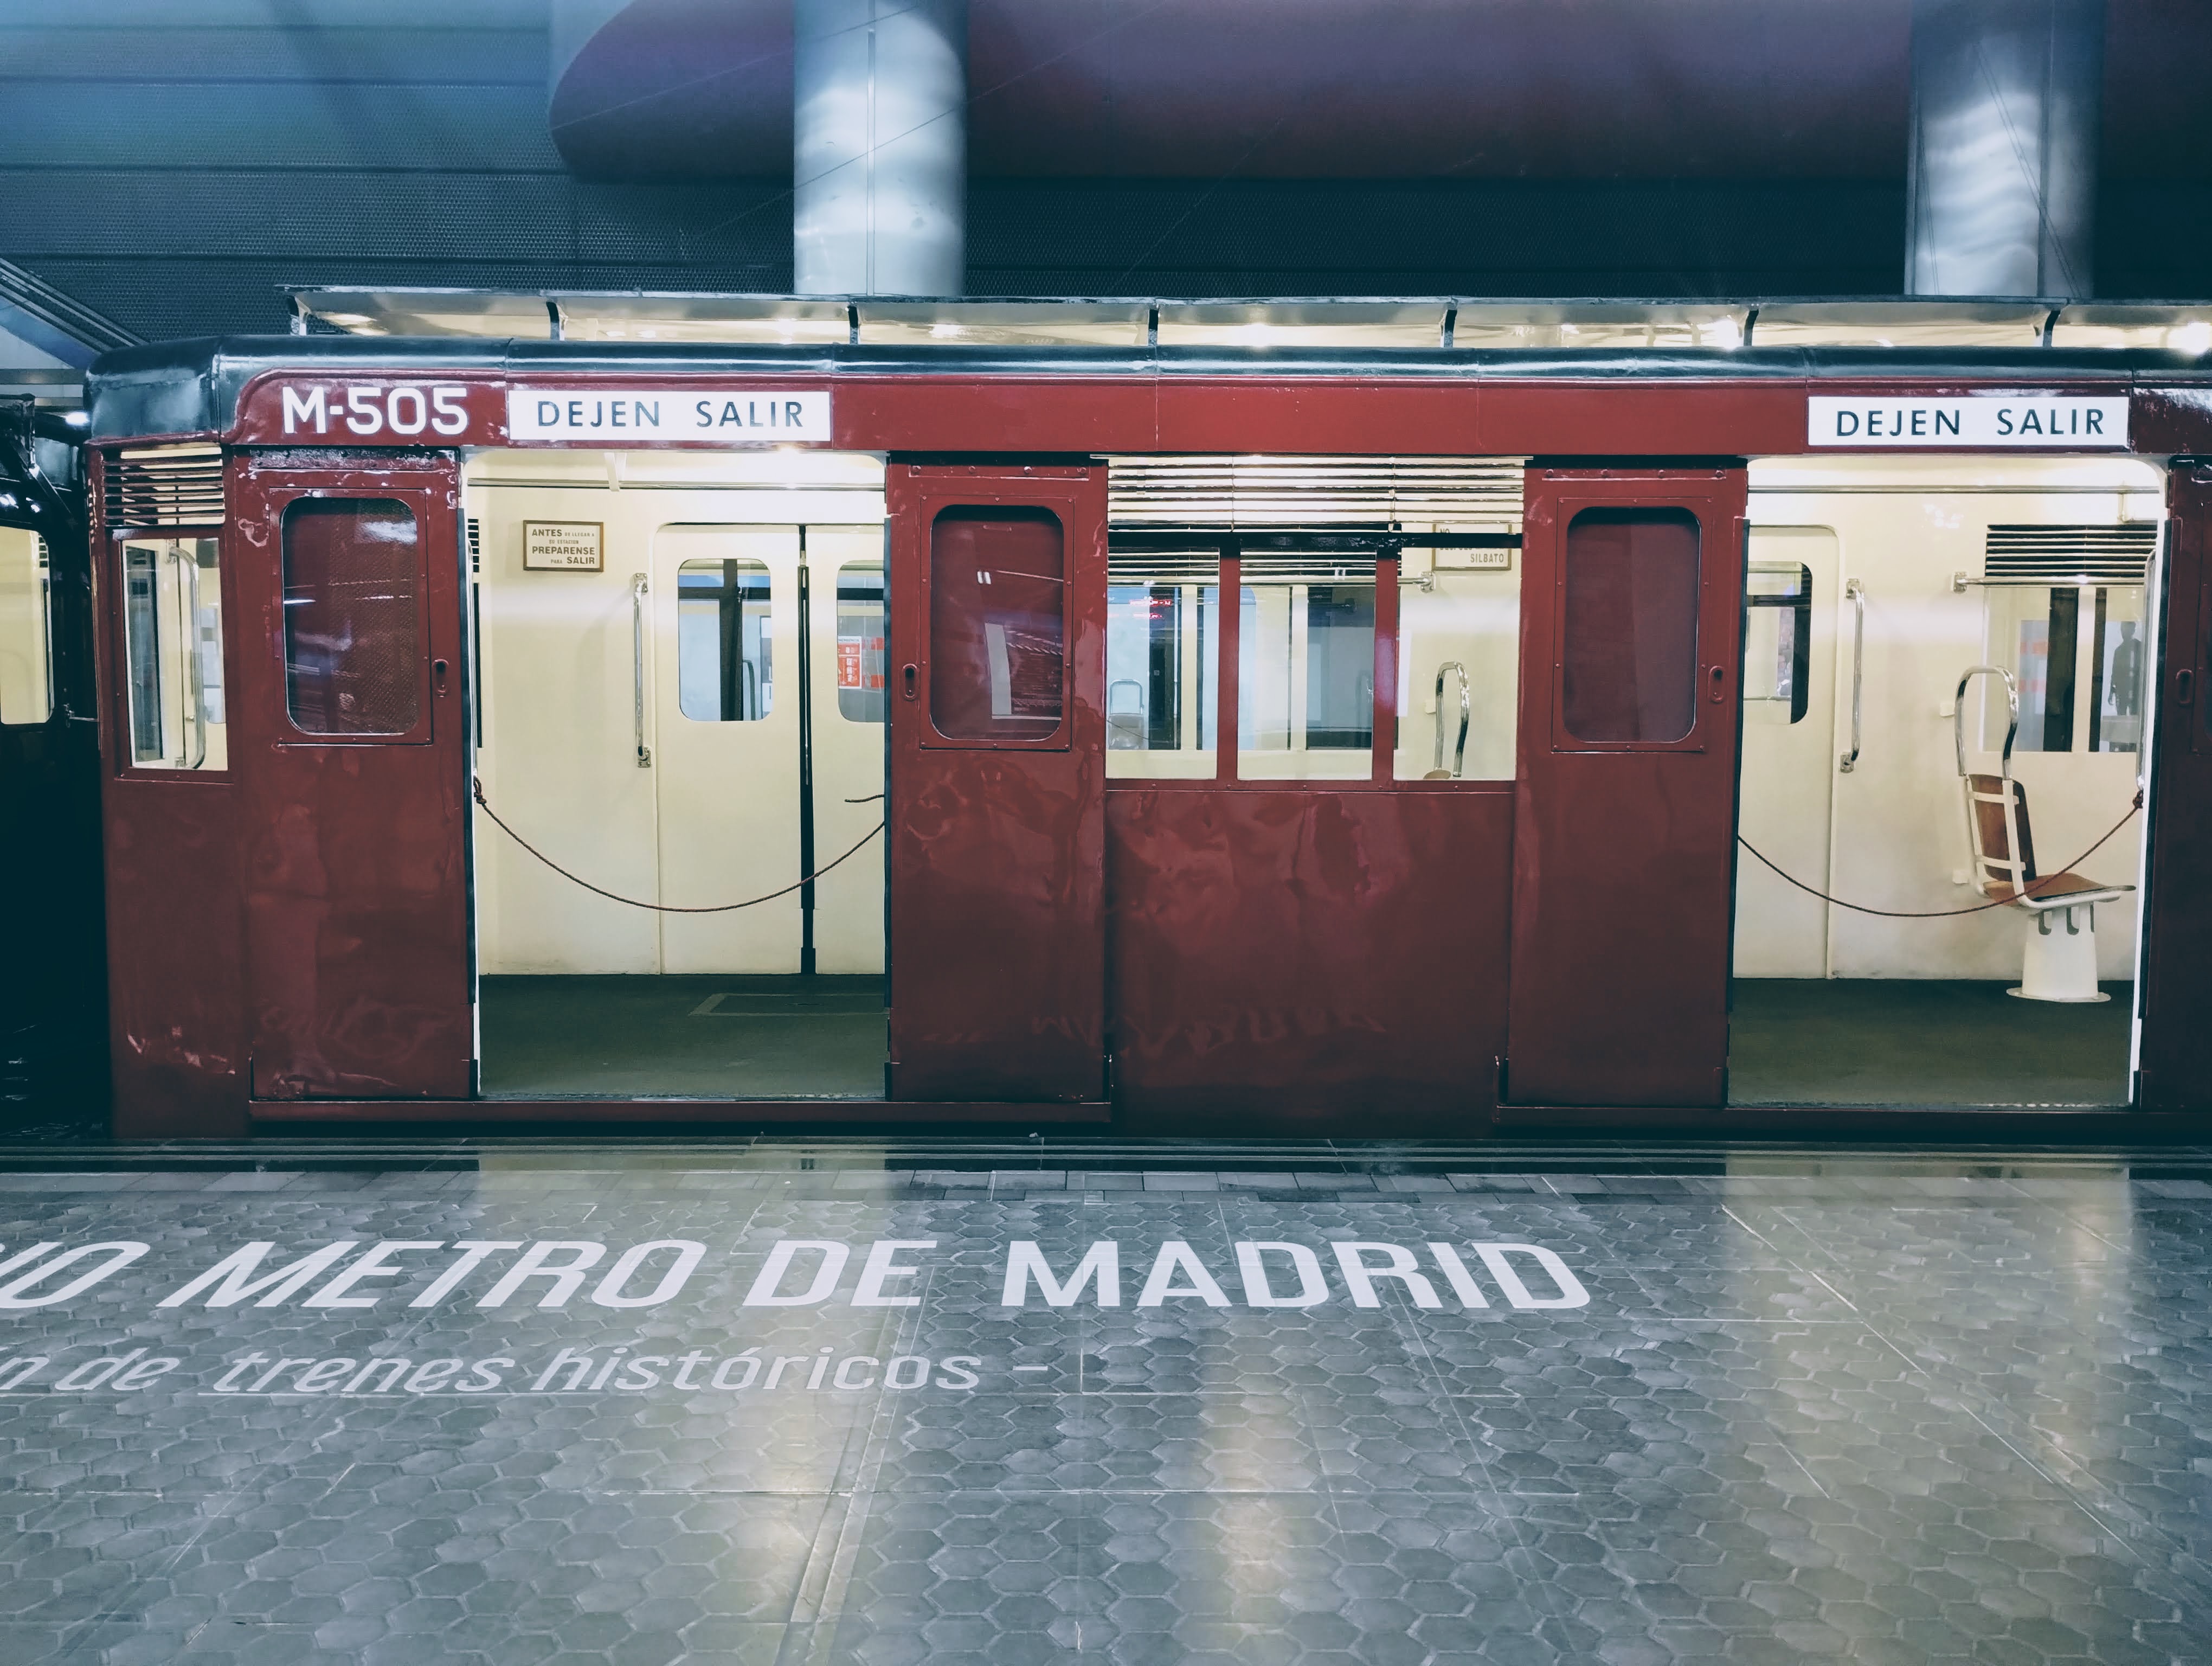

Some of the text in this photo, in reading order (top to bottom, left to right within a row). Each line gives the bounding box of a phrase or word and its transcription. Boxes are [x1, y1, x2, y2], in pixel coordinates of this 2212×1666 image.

[282, 386, 469, 435] M-505
[537, 400, 804, 428] DEJEN SALIR
[1836, 407, 2105, 437] DEJEN SALIR
[532, 529, 562, 537] ANTES
[532, 546, 595, 555] PREPARENSE
[567, 556, 595, 565] SALIR
[1470, 553, 1504, 563] SILBATO
[156, 1240, 707, 1308] METRO
[742, 1240, 937, 1306] DE
[1001, 1240, 1591, 1309] MADRID
[55, 1347, 181, 1391] de
[215, 1353, 516, 1392] trenes
[529, 1347, 981, 1391] históricos
